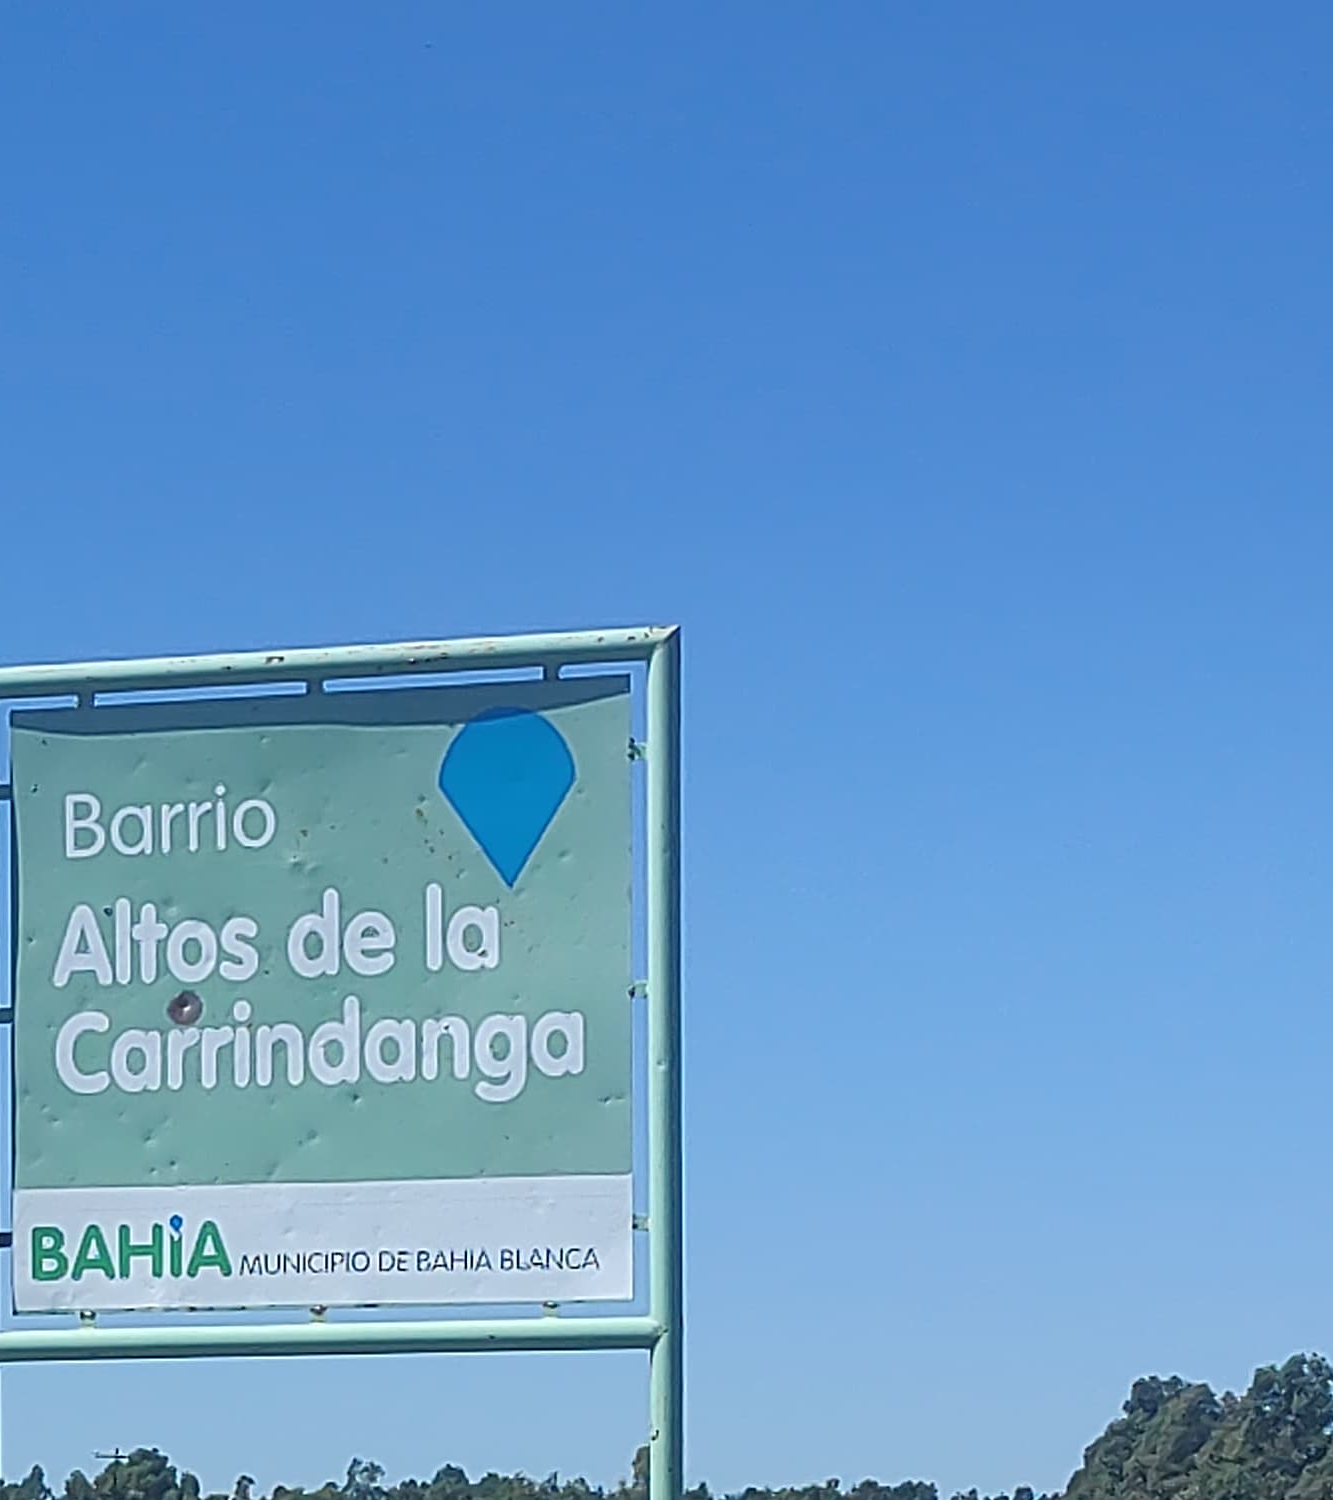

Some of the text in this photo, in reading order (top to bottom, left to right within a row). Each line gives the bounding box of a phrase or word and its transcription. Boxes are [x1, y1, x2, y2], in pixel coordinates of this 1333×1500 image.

[64, 784, 276, 858] Barrio
[53, 883, 500, 987] Altos de la
[55, 995, 585, 1101] Carrindanga
[238, 1247, 600, 1276] MUNICIPIO DE BAHIA BLANCA
